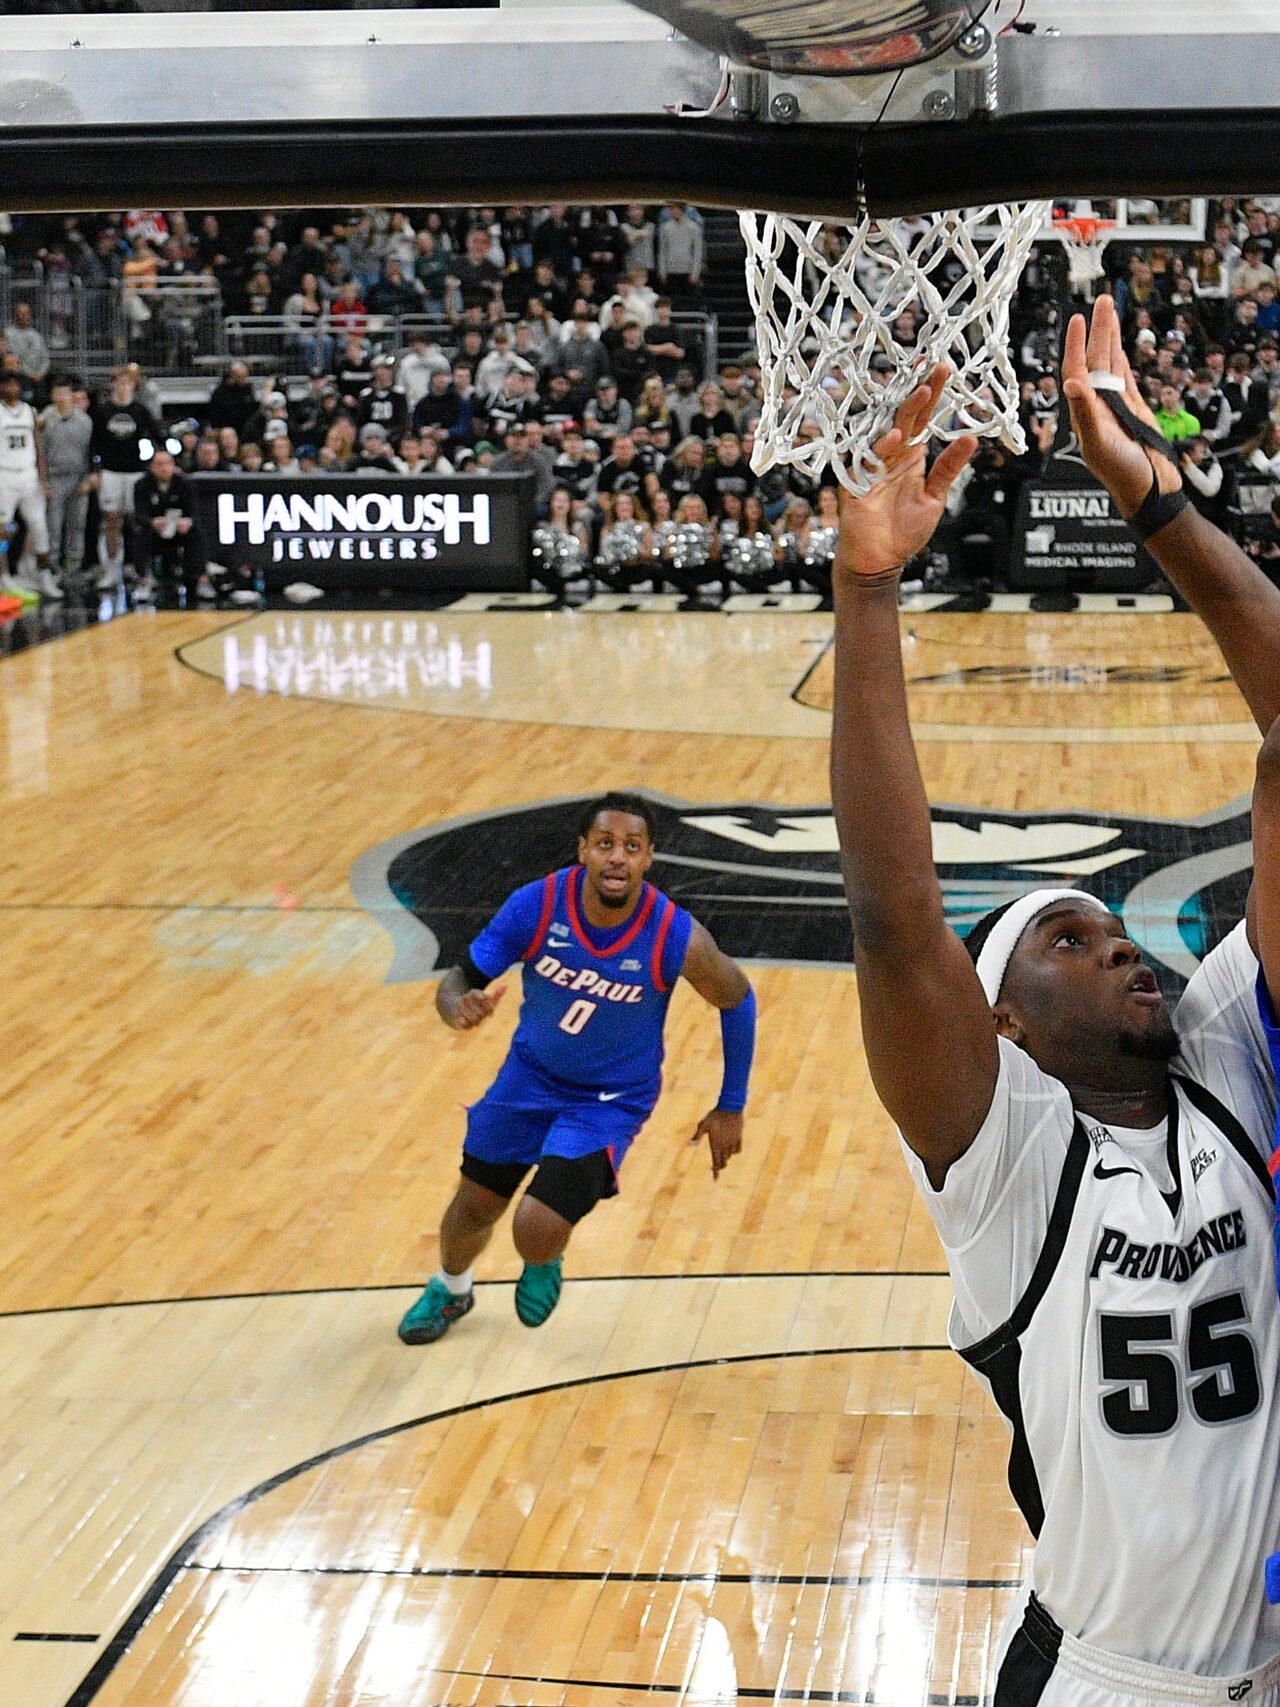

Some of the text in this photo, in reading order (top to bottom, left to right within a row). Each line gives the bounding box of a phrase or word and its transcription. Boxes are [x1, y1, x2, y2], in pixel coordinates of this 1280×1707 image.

[218, 493, 490, 545] HANNOUSH
[272, 537, 438, 562] JEWELERS
[557, 999, 598, 1035] 0
[1096, 1287, 1263, 1441] 55
